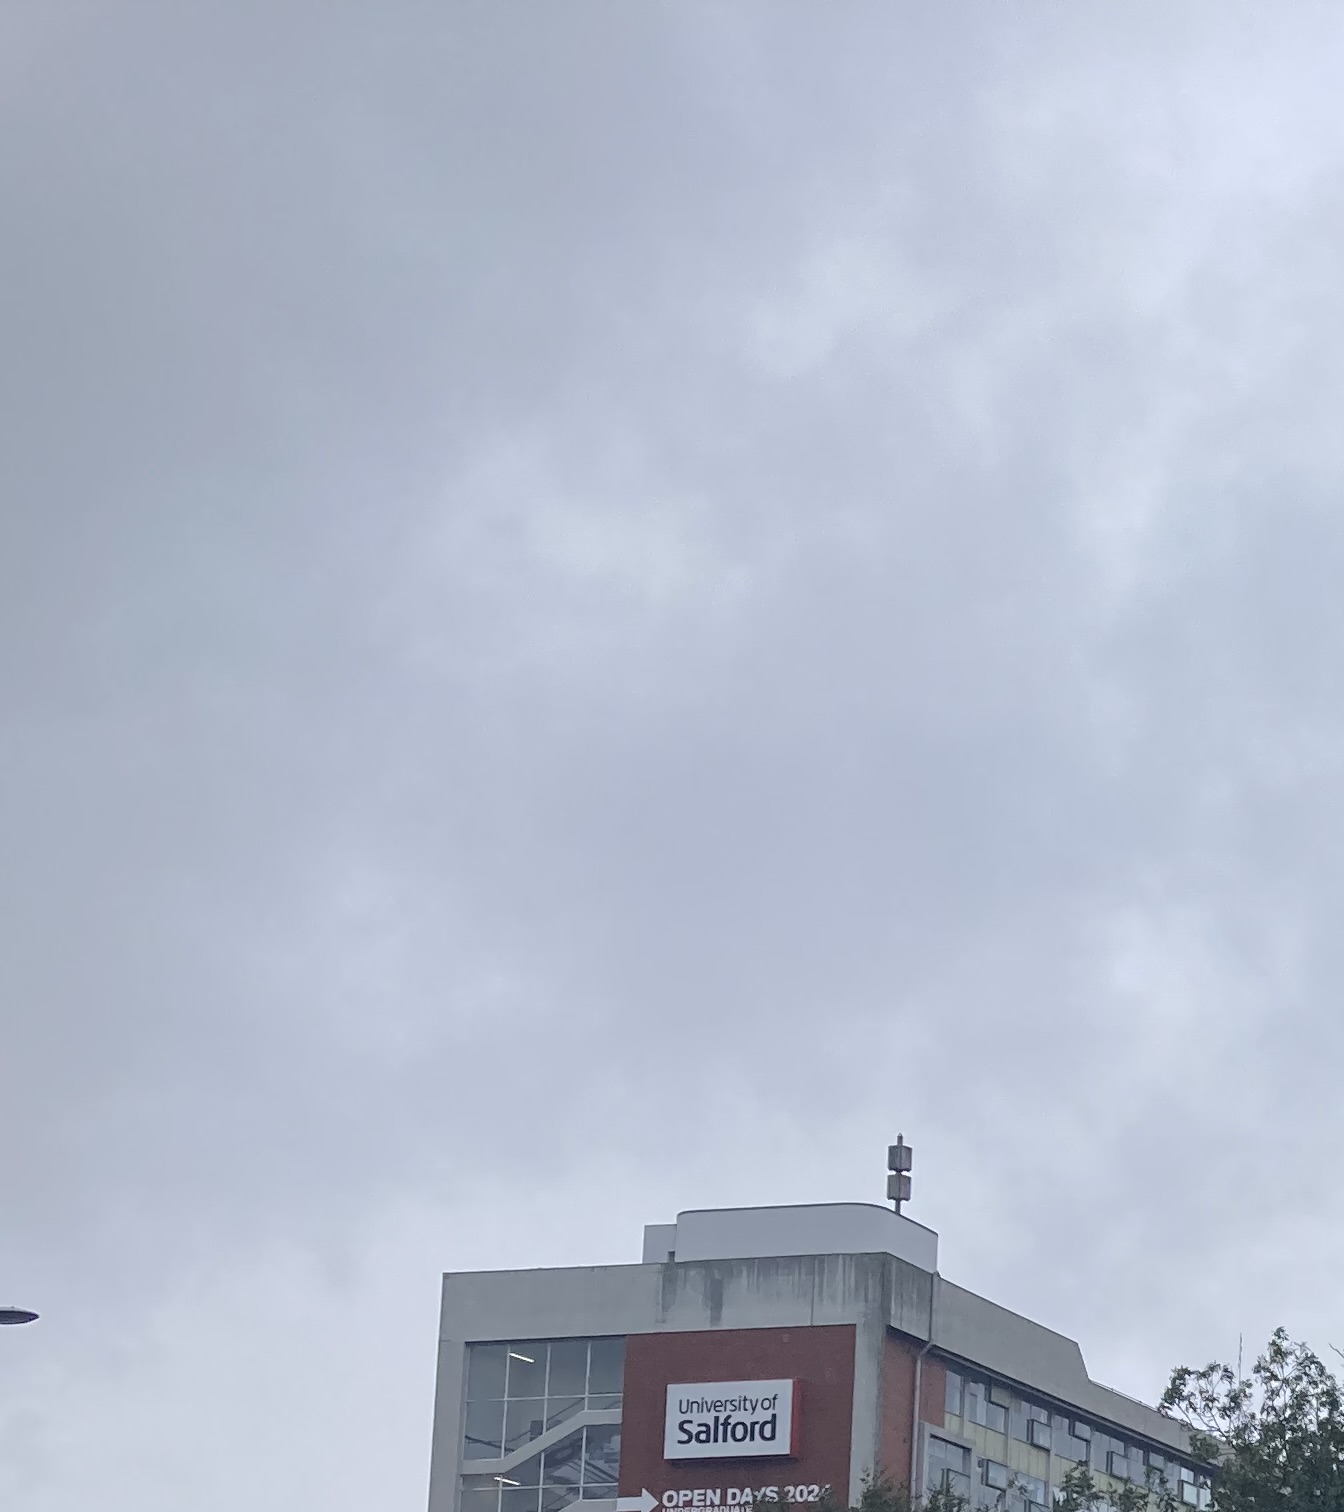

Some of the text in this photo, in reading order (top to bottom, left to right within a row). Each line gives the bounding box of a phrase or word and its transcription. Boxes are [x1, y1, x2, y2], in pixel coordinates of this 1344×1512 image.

[678, 1393, 779, 1415] University of
[676, 1413, 777, 1445] Salford
[661, 1487, 721, 1508] OPEN
[726, 1485, 779, 1506] DAYS
